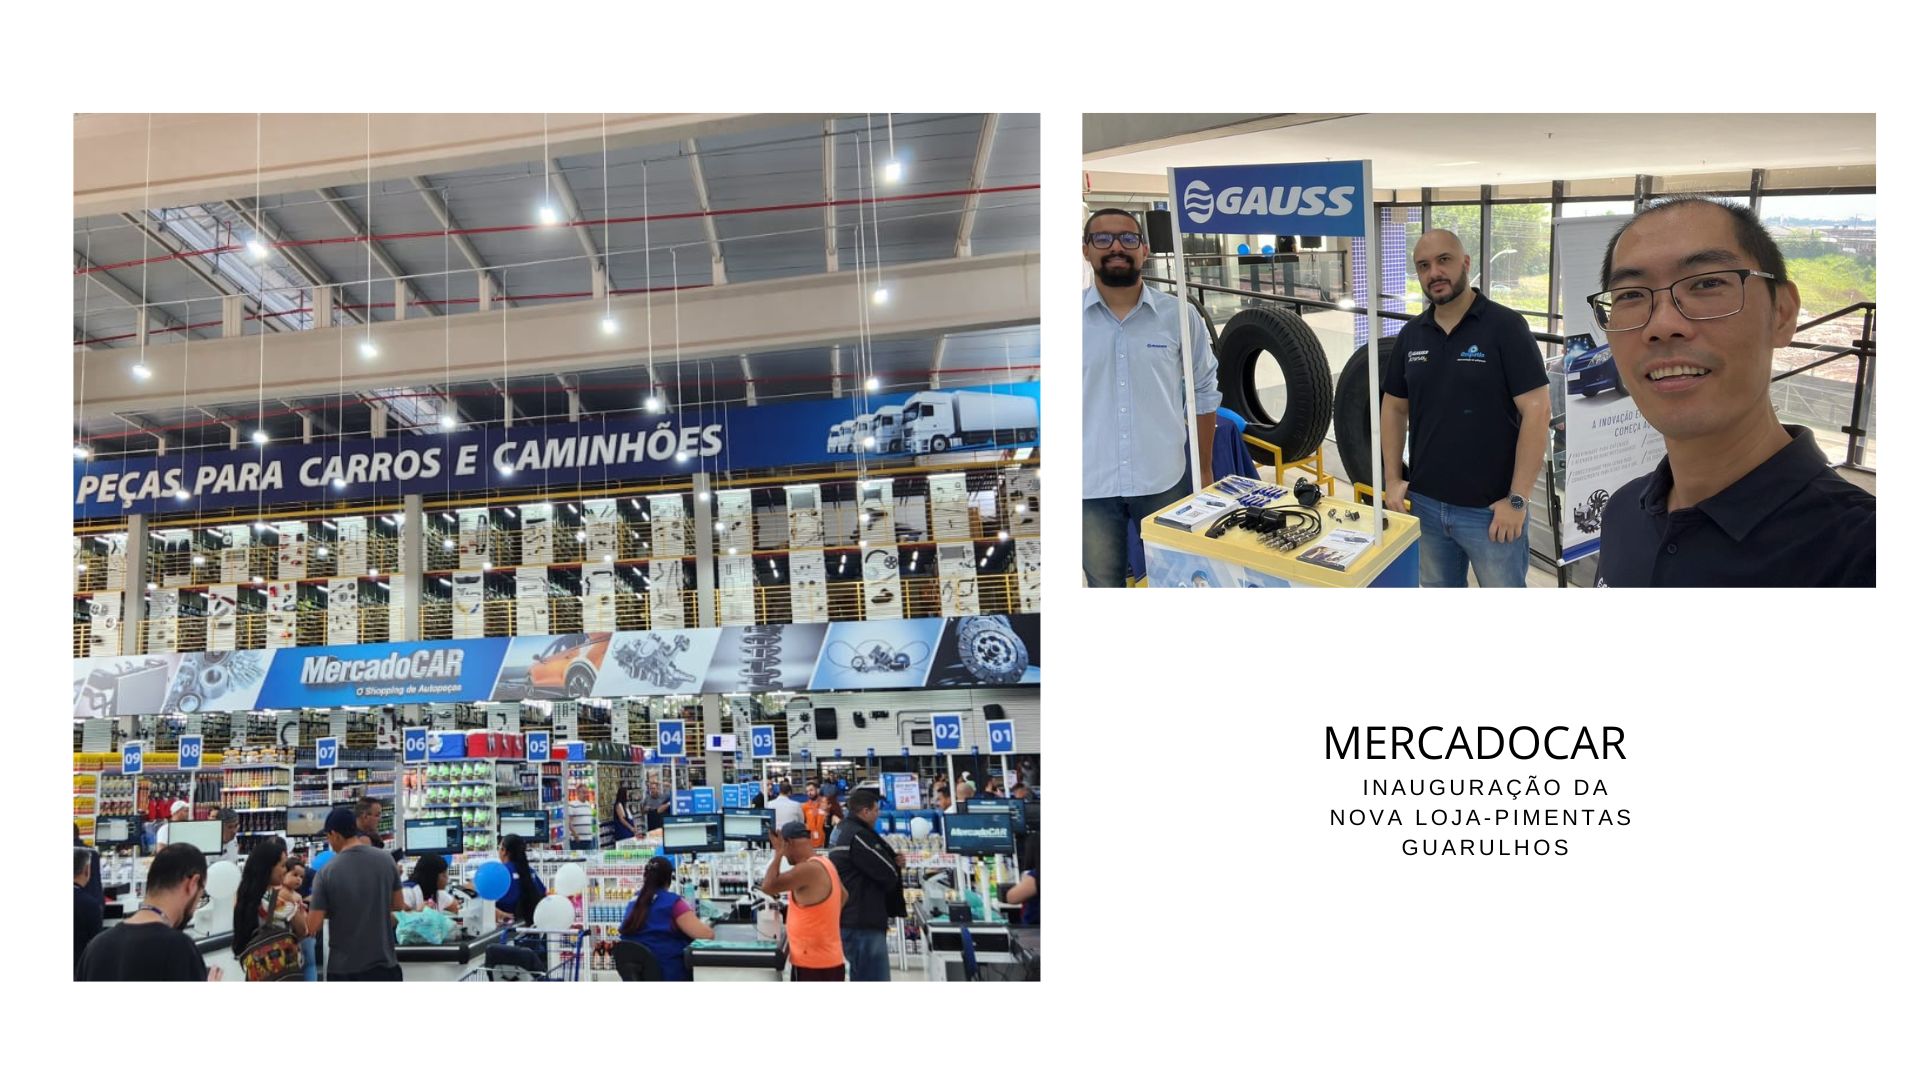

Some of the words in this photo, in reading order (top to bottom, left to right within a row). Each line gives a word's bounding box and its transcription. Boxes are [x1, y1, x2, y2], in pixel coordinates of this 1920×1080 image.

[1216, 186, 1355, 217] GAUSS
[1592, 419, 1597, 429] A
[1599, 410, 1633, 428] INOVAÇÃO
[1614, 421, 1641, 437] COMEÇA
[76, 468, 182, 508] PEÇAS
[194, 460, 283, 495] PARA
[299, 448, 441, 487] CARROS
[455, 444, 479, 476] E
[493, 421, 723, 471] CAMINHÕES
[301, 649, 464, 684] MercadoCAR
[356, 687, 363, 696] O
[365, 685, 404, 697] Shopping
[406, 684, 416, 694] de
[418, 684, 462, 694] Autopeças
[660, 730, 682, 745] 04
[935, 723, 960, 739] 02
[992, 729, 1012, 743] 01
[406, 737, 425, 751] 06
[530, 740, 547, 753] 05
[753, 734, 772, 748] 03
[181, 744, 199, 758] 08
[320, 747, 335, 759] 07
[125, 752, 140, 765] 09
